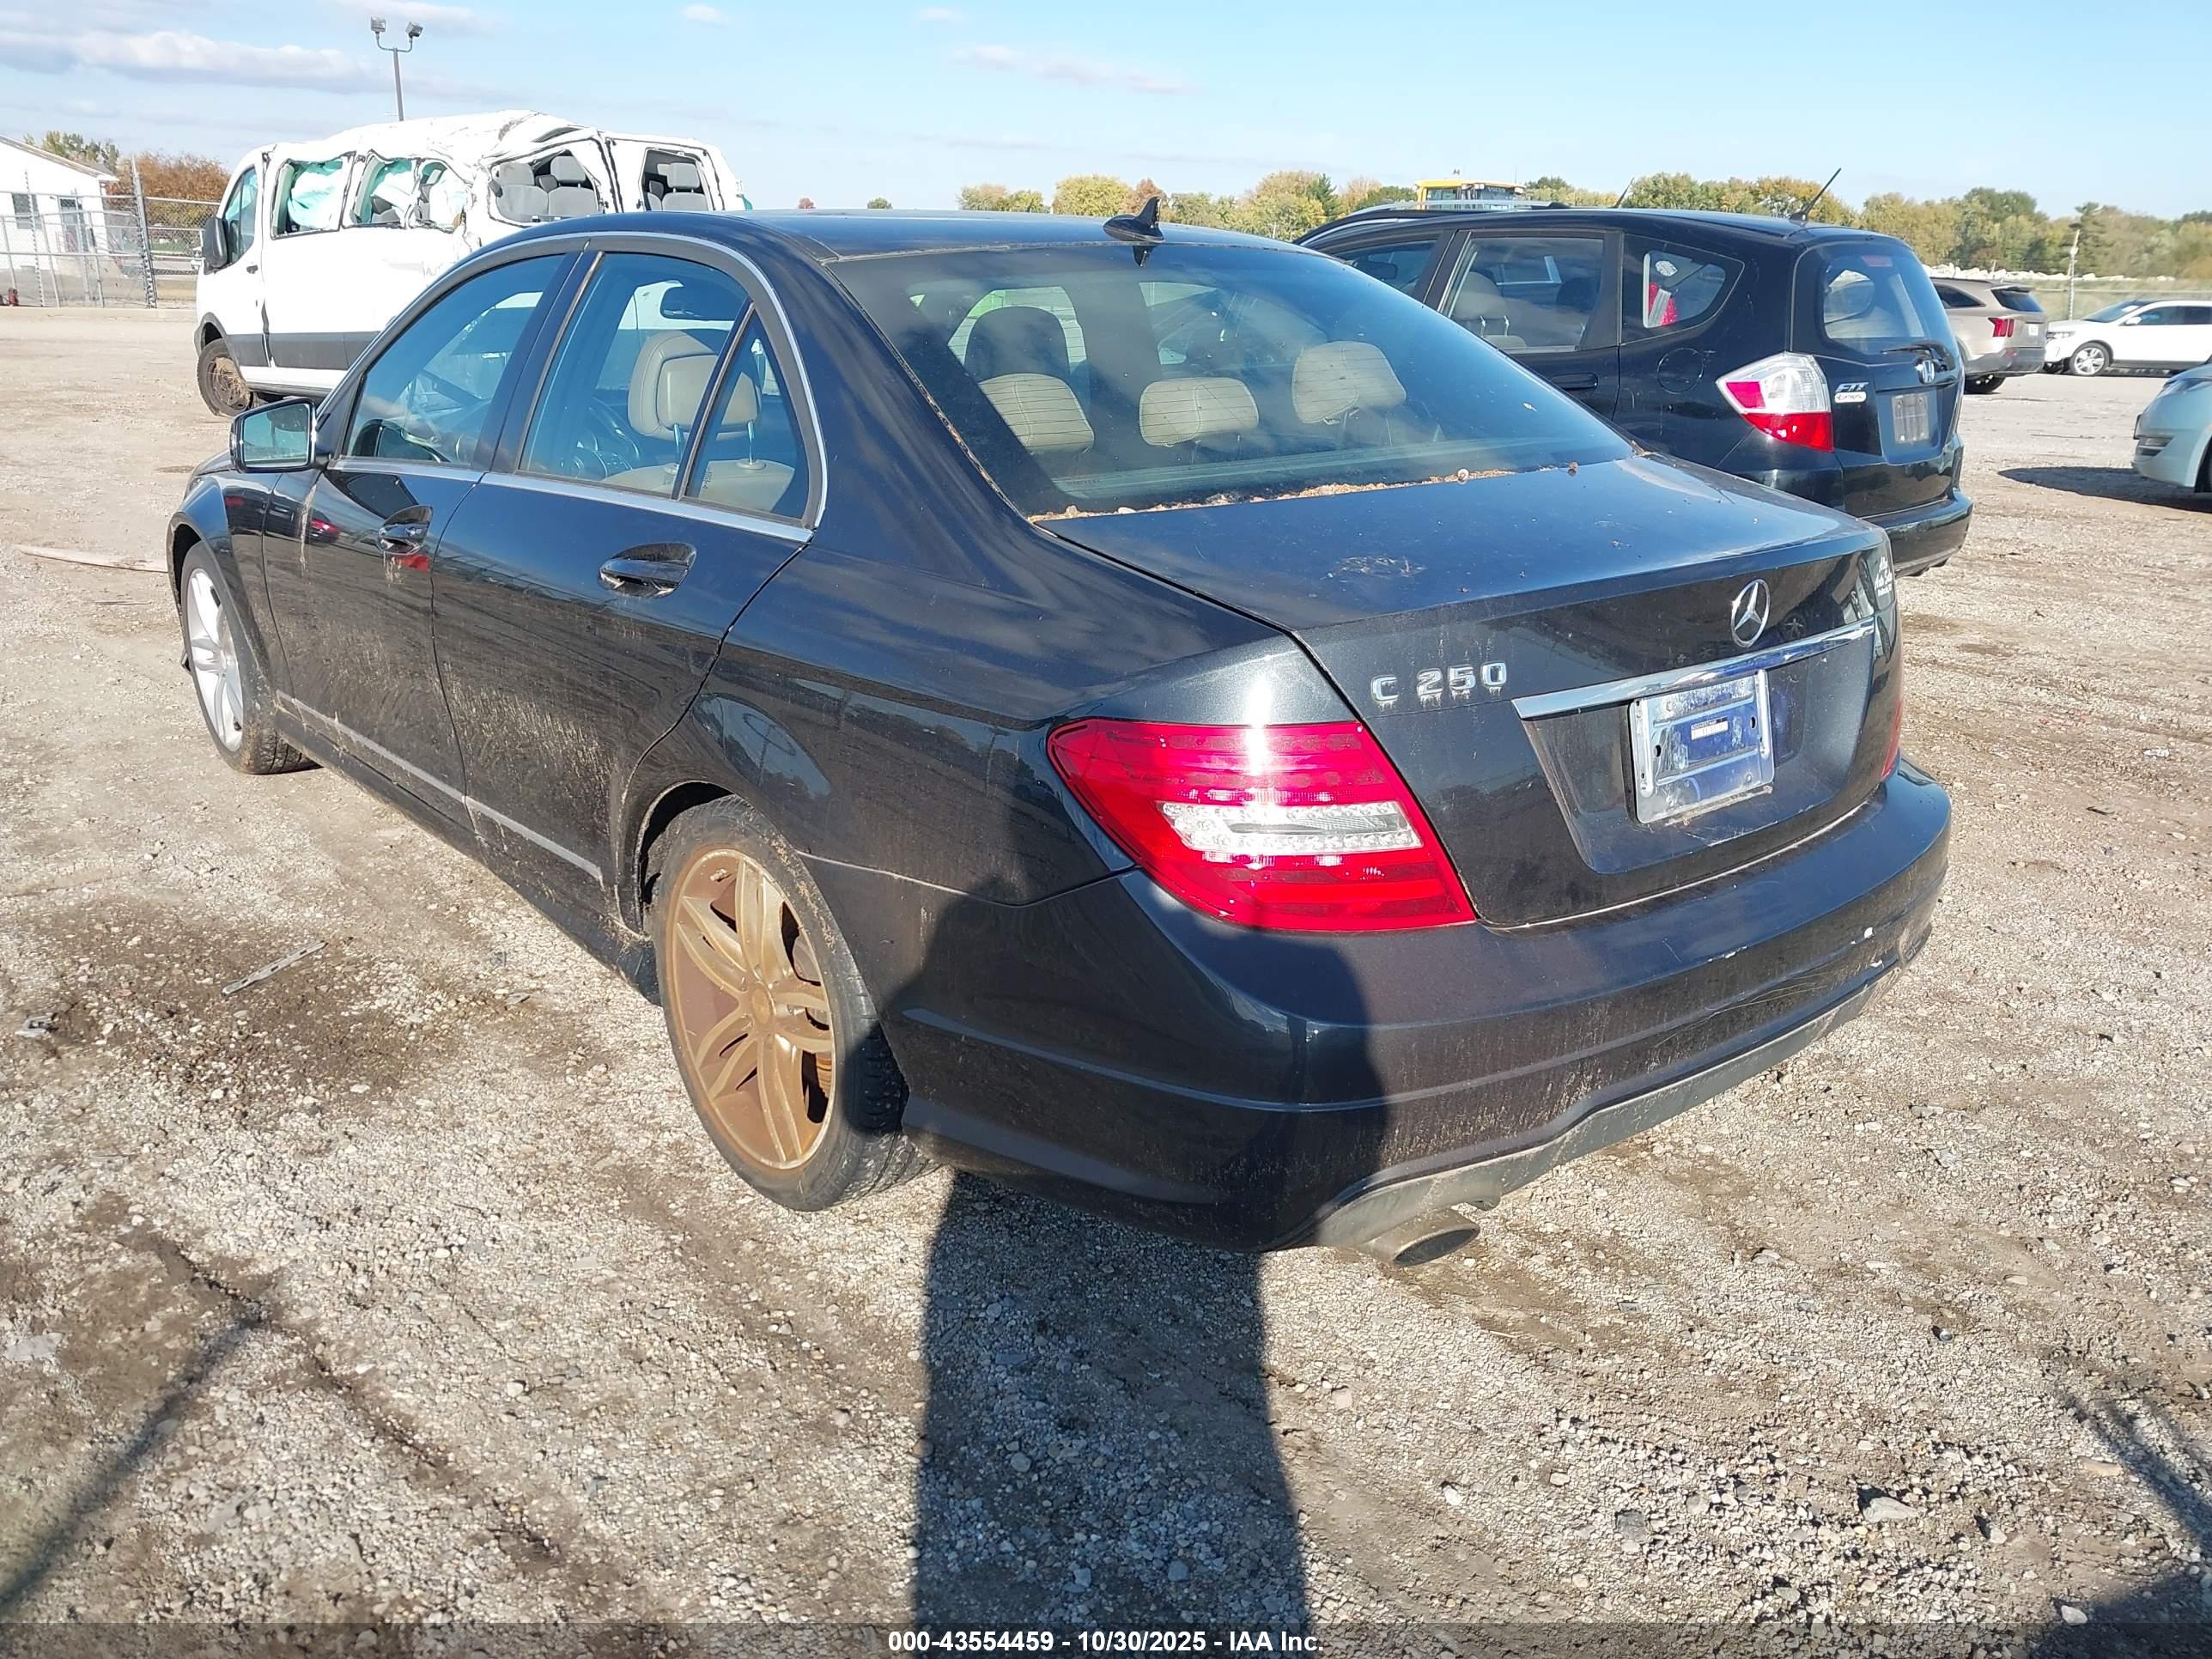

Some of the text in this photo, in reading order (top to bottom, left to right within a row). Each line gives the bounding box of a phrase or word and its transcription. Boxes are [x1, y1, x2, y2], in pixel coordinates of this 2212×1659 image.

[1834, 381, 1869, 392] FIT
[1371, 660, 1507, 702] C 250
